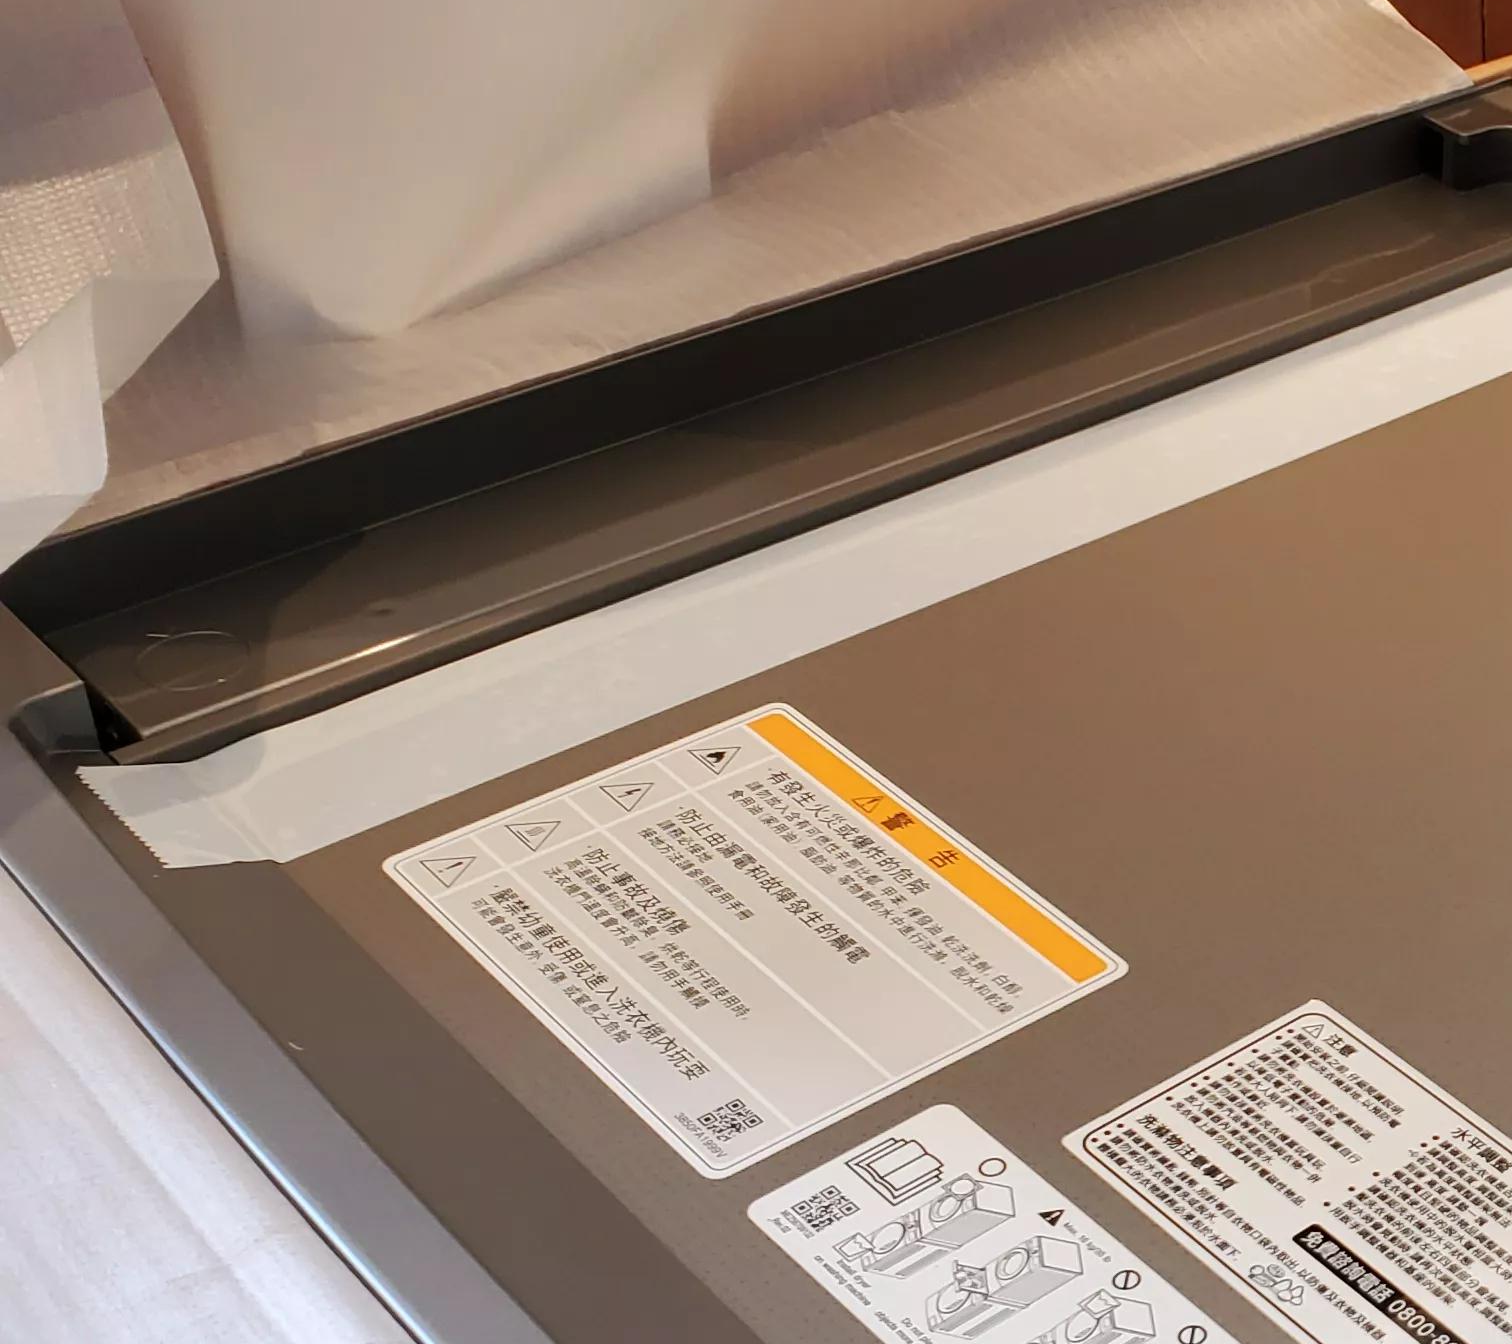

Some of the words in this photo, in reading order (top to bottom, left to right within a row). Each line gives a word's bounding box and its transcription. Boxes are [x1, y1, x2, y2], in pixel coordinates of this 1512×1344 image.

[670, 807, 876, 966] 防止由漏電和故障發生的觸電
[759, 768, 937, 897] 有發生火災或爆炸的危險
[874, 809, 967, 871] 警告
[578, 846, 694, 937] 防止事故及燒傷
[485, 885, 714, 1083] 嚴禁幼童使用或進入洗衣機內玩耍
[1321, 1032, 1359, 1059] 注意
